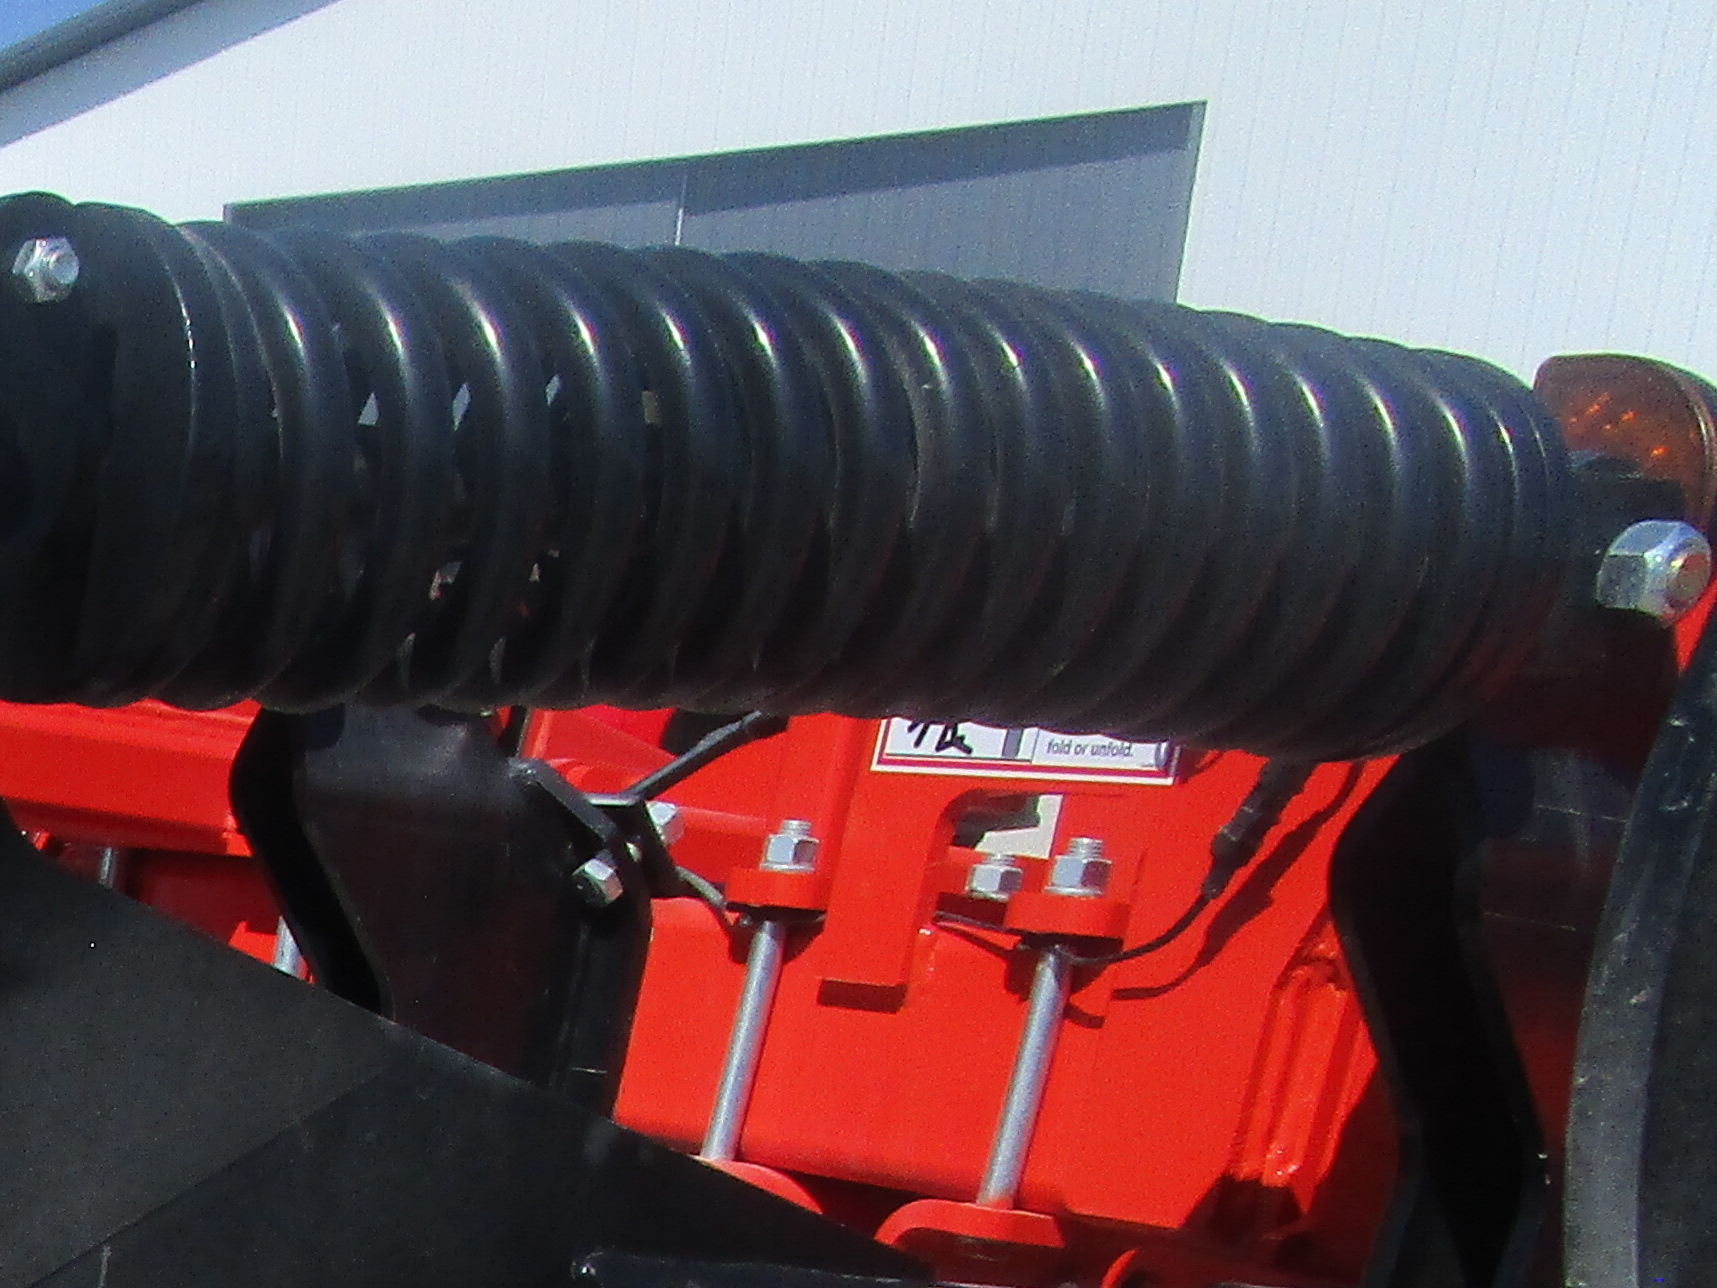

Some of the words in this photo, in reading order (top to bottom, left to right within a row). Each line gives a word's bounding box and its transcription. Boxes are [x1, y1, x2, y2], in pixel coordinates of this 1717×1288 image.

[1046, 738, 1073, 755] fold
[1074, 742, 1090, 756] or
[1090, 741, 1135, 758] unfold.
